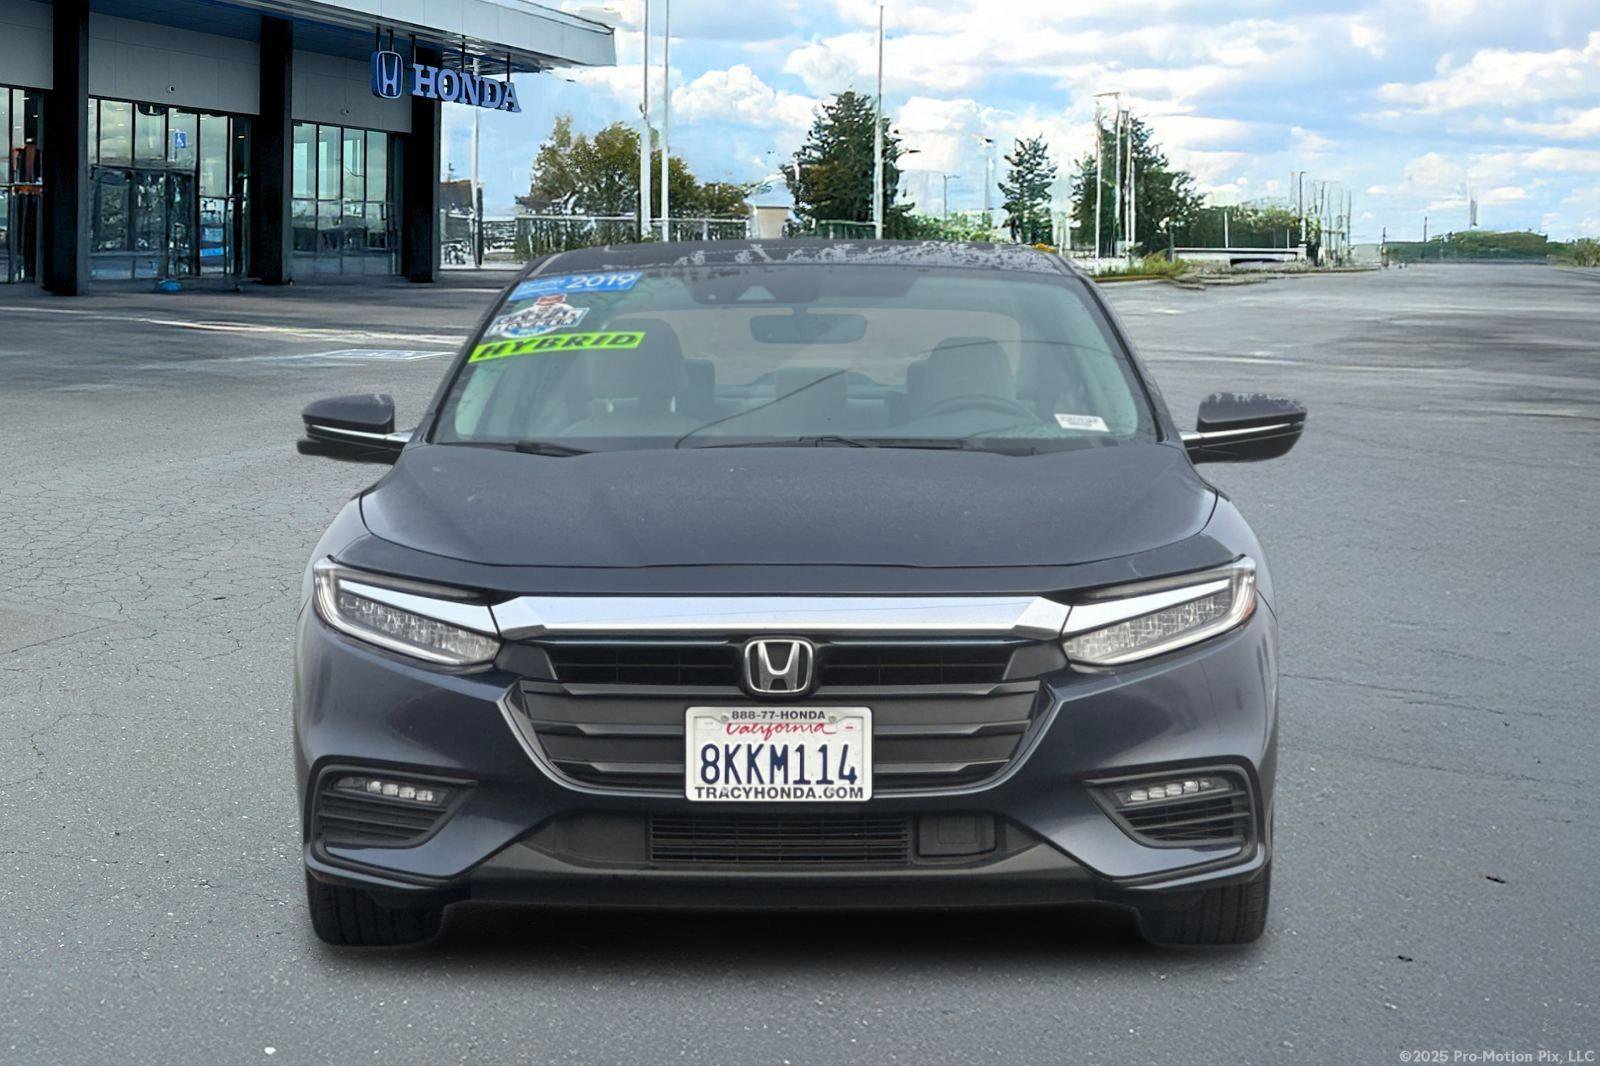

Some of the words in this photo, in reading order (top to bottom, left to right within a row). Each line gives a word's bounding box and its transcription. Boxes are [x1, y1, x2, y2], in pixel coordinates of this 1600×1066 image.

[412, 63, 521, 112] HONDA
[566, 273, 636, 290] 2019
[477, 333, 636, 359] HYBRID
[731, 710, 826, 720] 888-77-HONDA
[701, 743, 858, 785] 8KKM114
[694, 786, 864, 799] TRACYHONDA.COM
